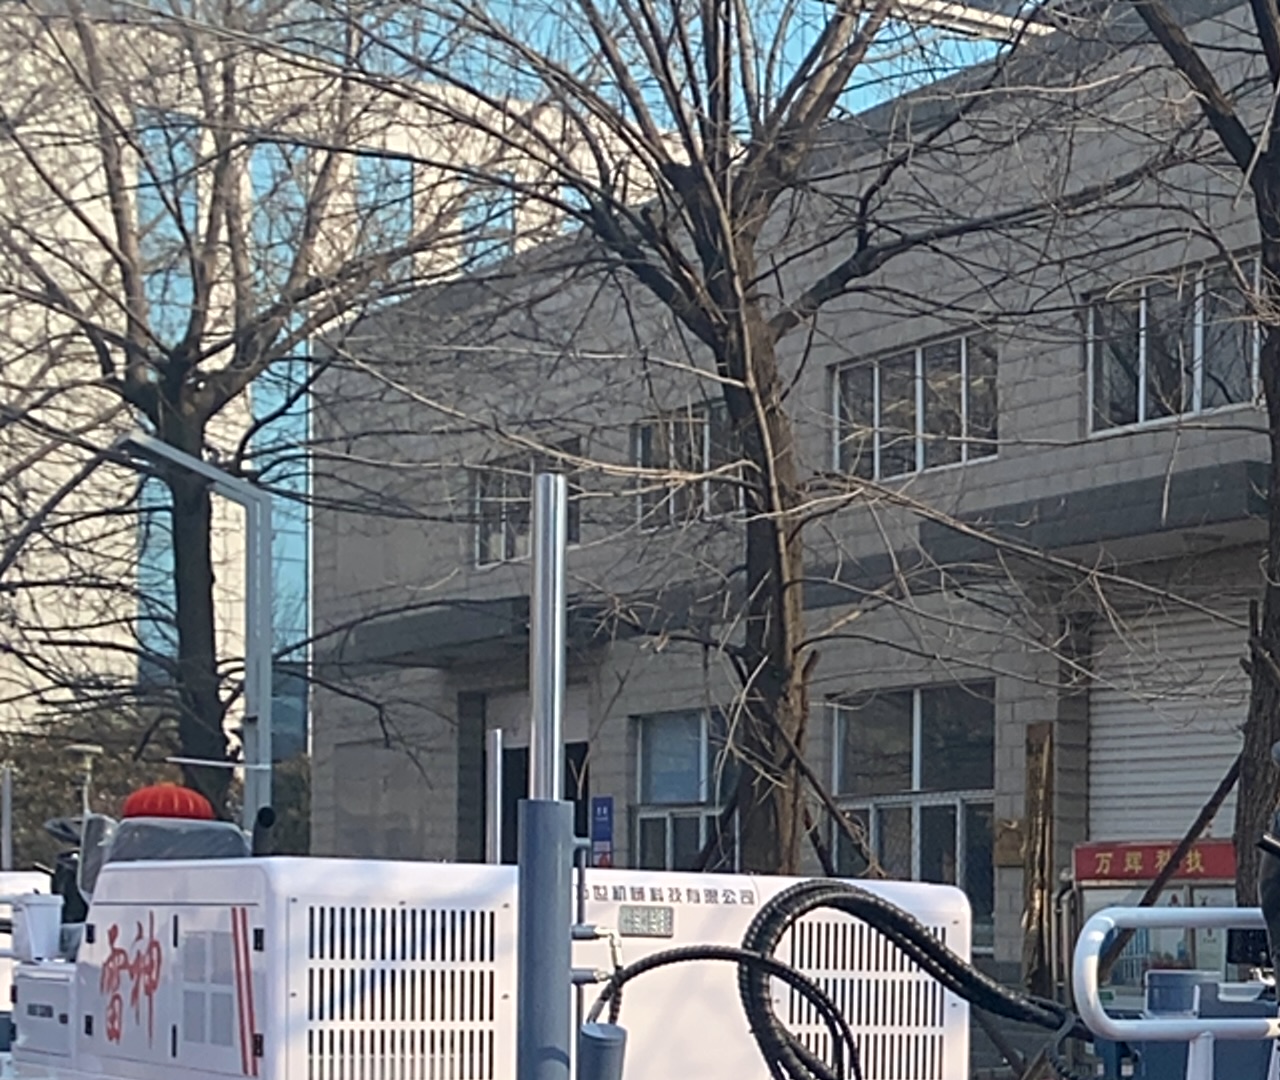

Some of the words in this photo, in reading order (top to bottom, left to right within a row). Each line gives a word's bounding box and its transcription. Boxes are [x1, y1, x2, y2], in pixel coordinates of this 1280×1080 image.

[1095, 849, 1204, 875] 万辉科技
[101, 910, 162, 1049] 雷神
